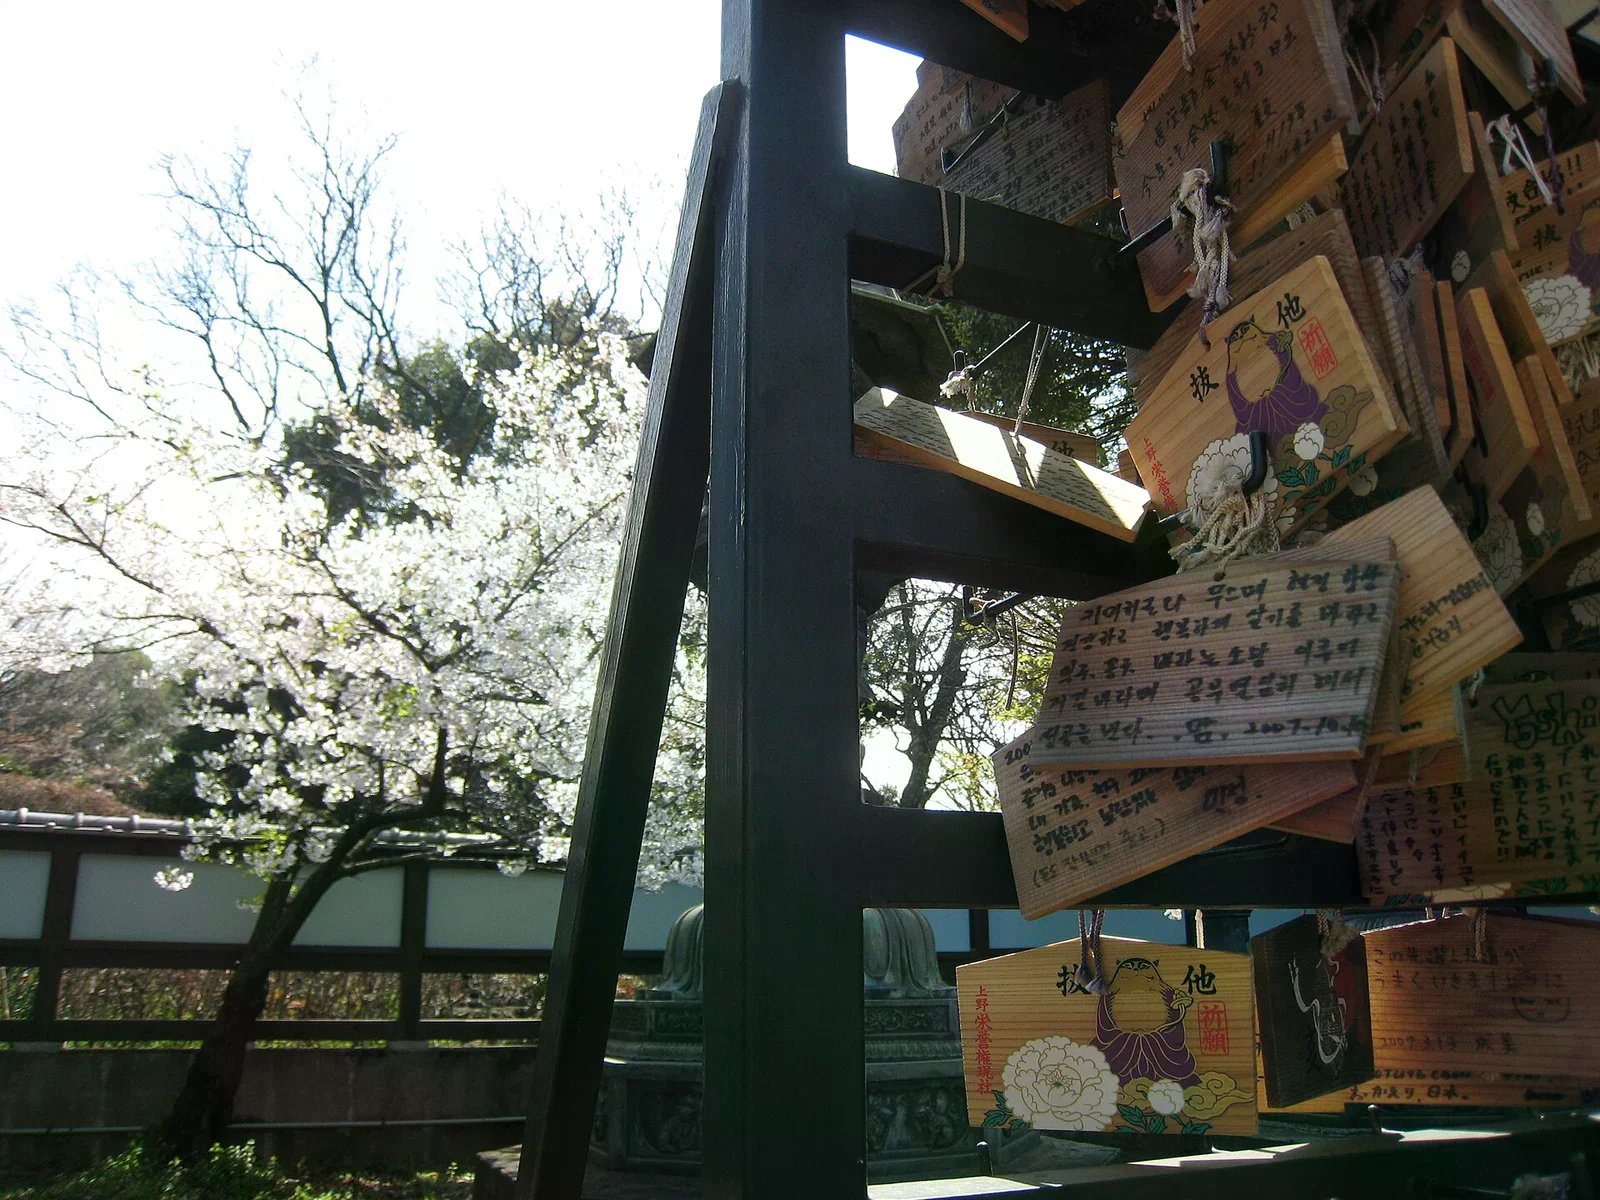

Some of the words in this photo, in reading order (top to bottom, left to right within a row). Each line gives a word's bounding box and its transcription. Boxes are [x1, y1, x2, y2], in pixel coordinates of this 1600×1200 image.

[1276, 292, 1307, 329] 他
[1189, 366, 1219, 402] 抜
[1004, 742, 1033, 766] 200
[1181, 963, 1217, 995] 他
[974, 984, 994, 1094] 上野栄誉権現社
[1200, 1004, 1227, 1053] 祈願
